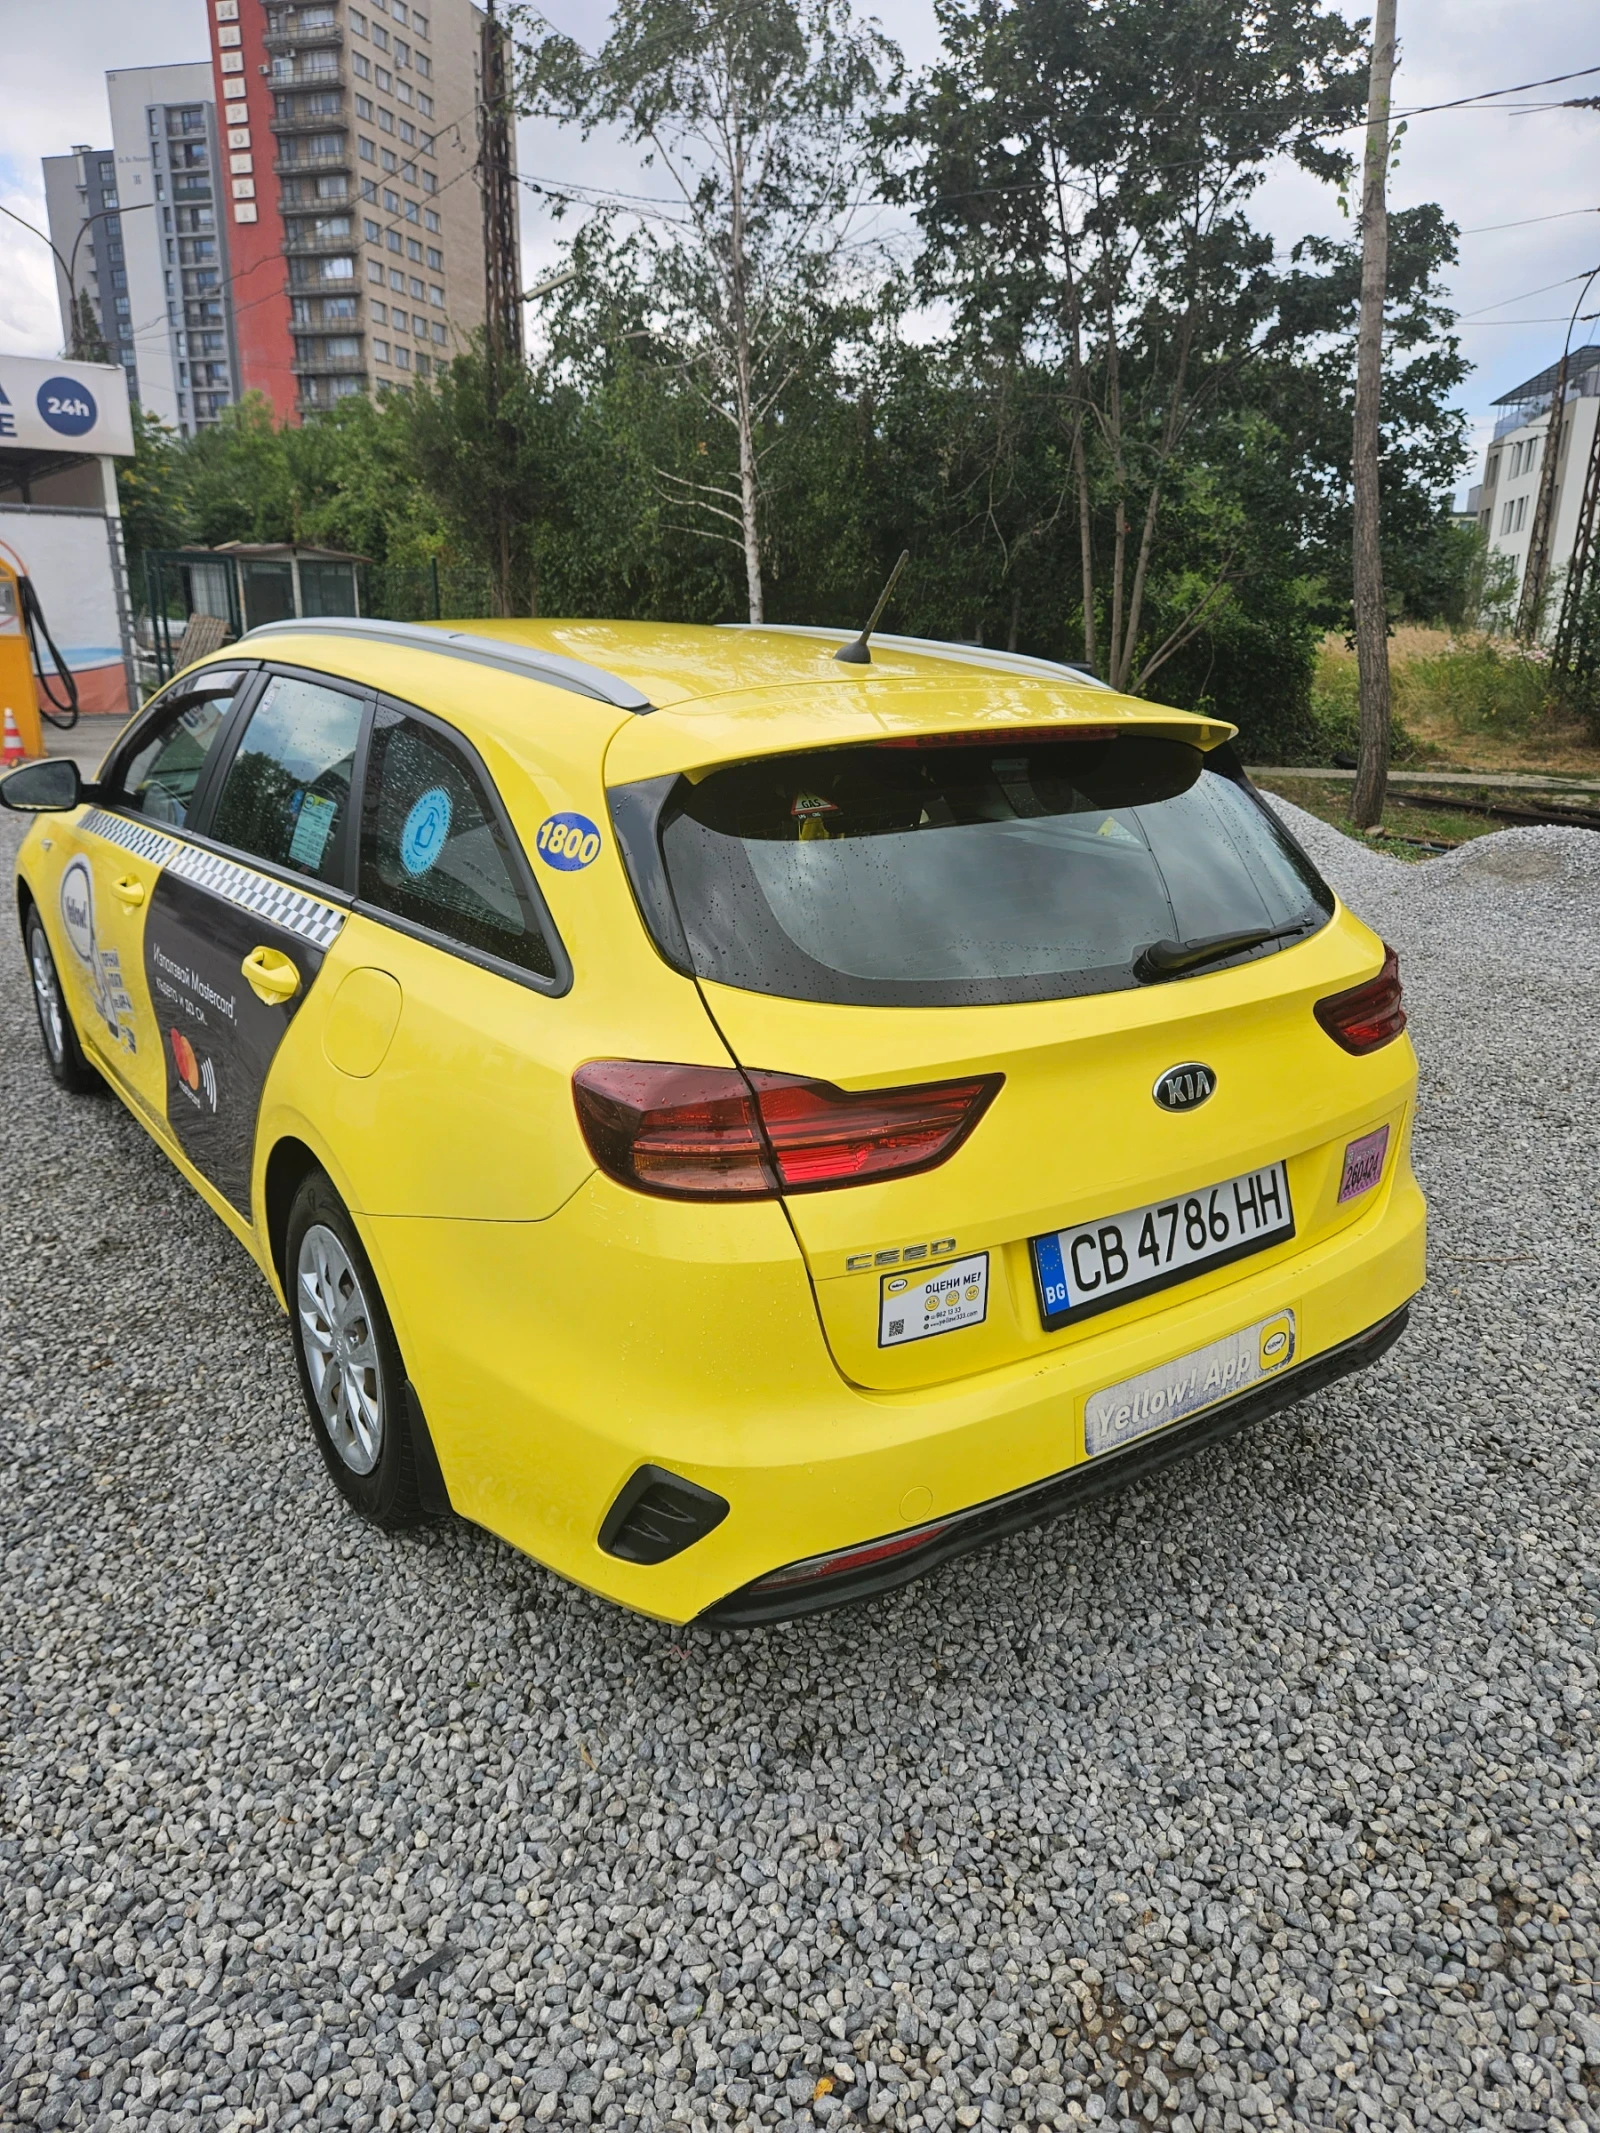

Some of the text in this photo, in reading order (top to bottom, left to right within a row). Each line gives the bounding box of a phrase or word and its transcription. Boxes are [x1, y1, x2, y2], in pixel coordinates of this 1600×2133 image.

[47, 397, 90, 417] 24h
[801, 799, 821, 808] GAS
[539, 820, 600, 864] 1800
[1165, 1071, 1210, 1105] KIA
[846, 1237, 956, 1271] CEED
[1046, 1169, 1283, 1305] BG CB 4786 HH
[925, 1271, 982, 1294] ОЦЕНИ МЕ!
[1098, 1350, 1251, 1437] Yellow! App
